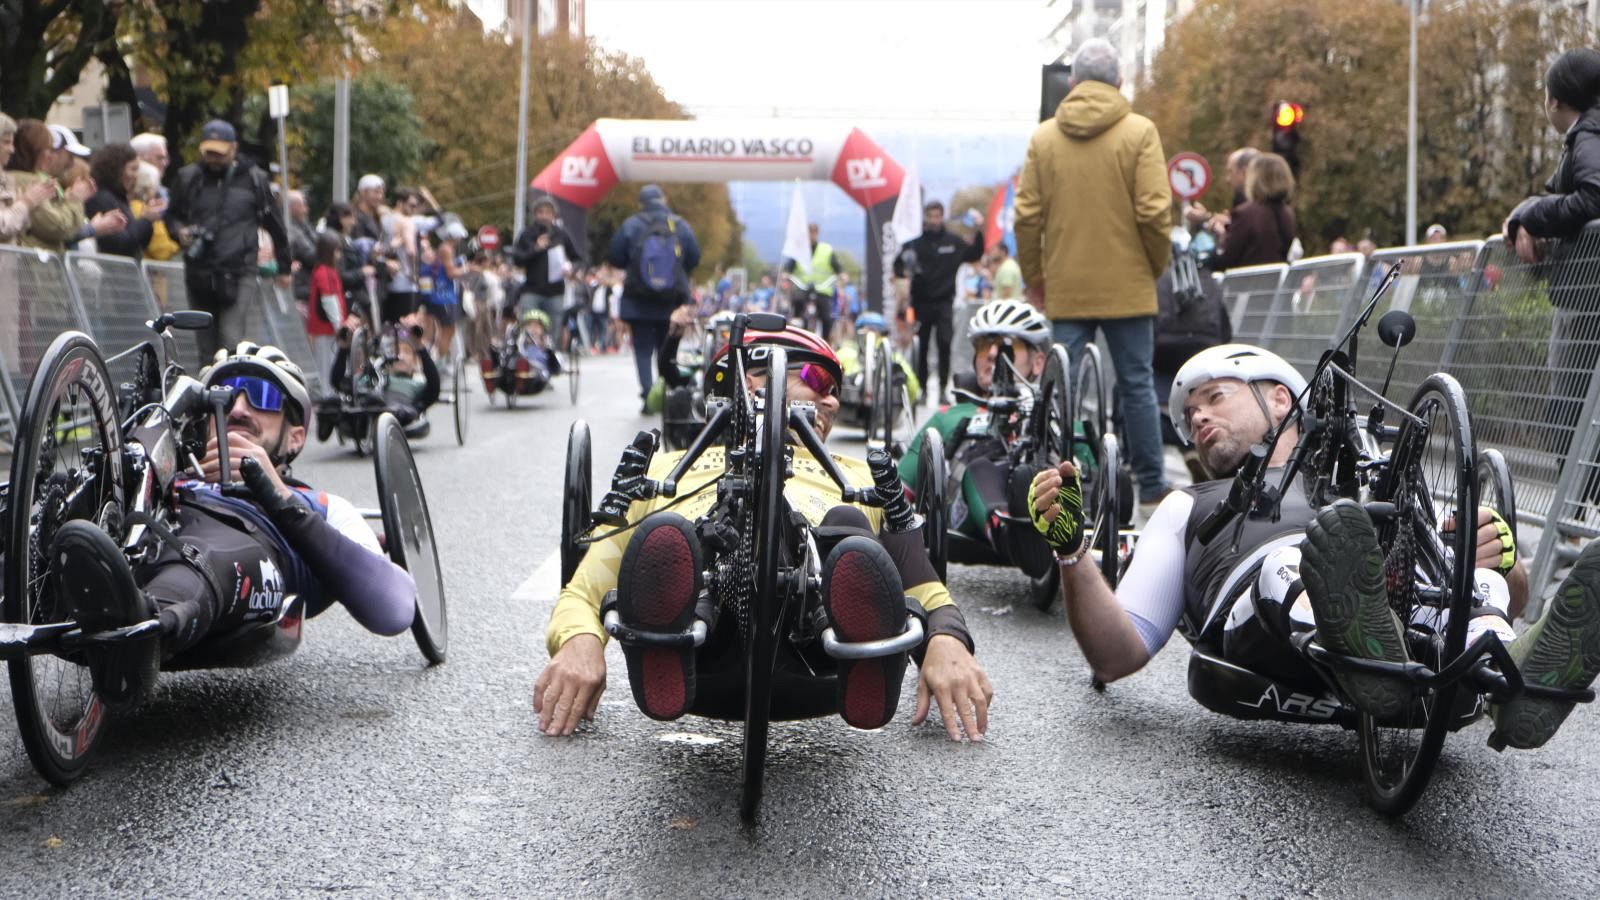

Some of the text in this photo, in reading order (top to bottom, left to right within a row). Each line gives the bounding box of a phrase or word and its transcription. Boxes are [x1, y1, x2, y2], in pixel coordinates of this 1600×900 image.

[632, 137, 814, 156] EL DIARIO VASCO
[561, 156, 599, 178] DV
[847, 158, 884, 179] DV
